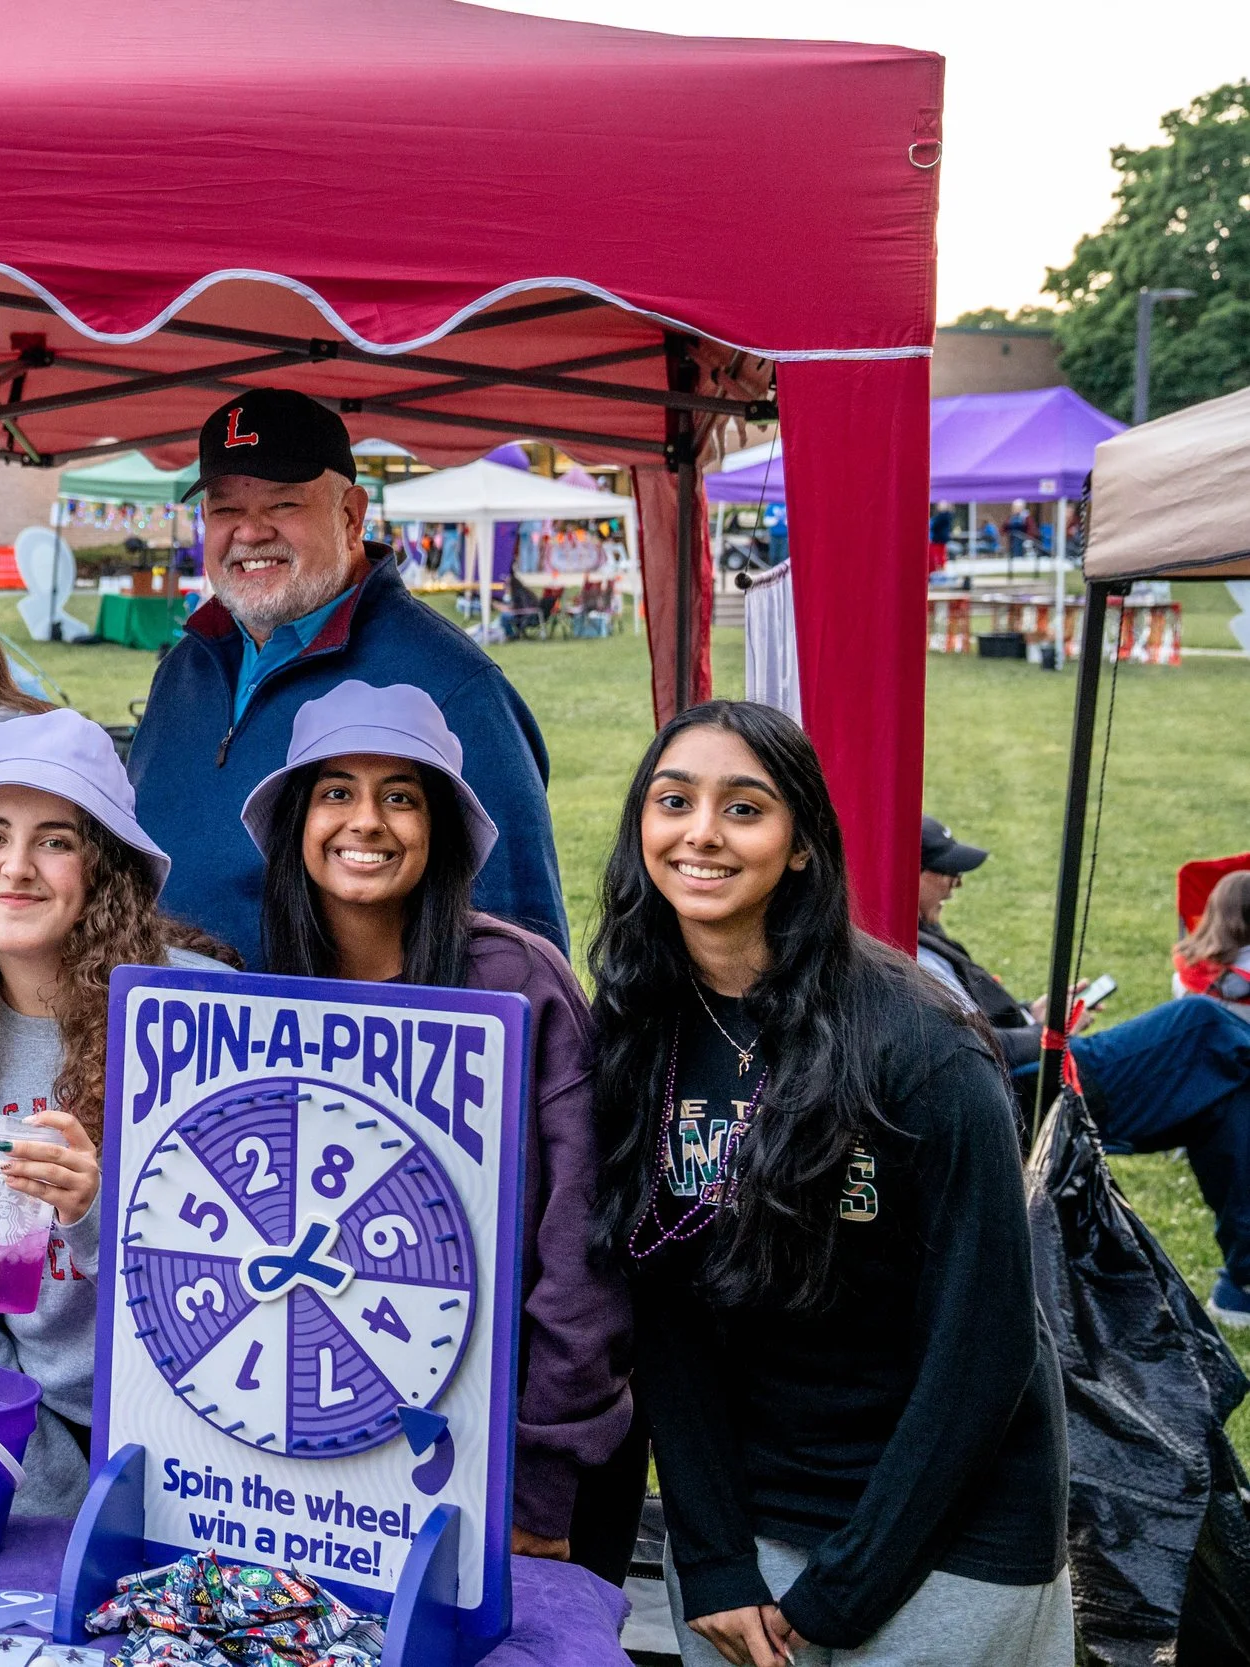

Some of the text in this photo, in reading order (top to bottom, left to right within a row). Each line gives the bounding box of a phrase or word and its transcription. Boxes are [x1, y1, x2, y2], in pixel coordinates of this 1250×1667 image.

[224, 408, 259, 448] L
[133, 998, 486, 1165] SPIN-A-PRIZE
[236, 1137, 279, 1194] 2
[311, 1145, 354, 1199] 8
[179, 1193, 228, 1242] 5
[176, 1278, 224, 1321] 3
[361, 1296, 411, 1343] 4
[236, 1341, 263, 1390] 1
[320, 1348, 354, 1407] 7
[163, 1458, 419, 1545] Spin the wheel,
[190, 1511, 246, 1548] win
[255, 1528, 276, 1555] a
[283, 1534, 382, 1577] prize!
